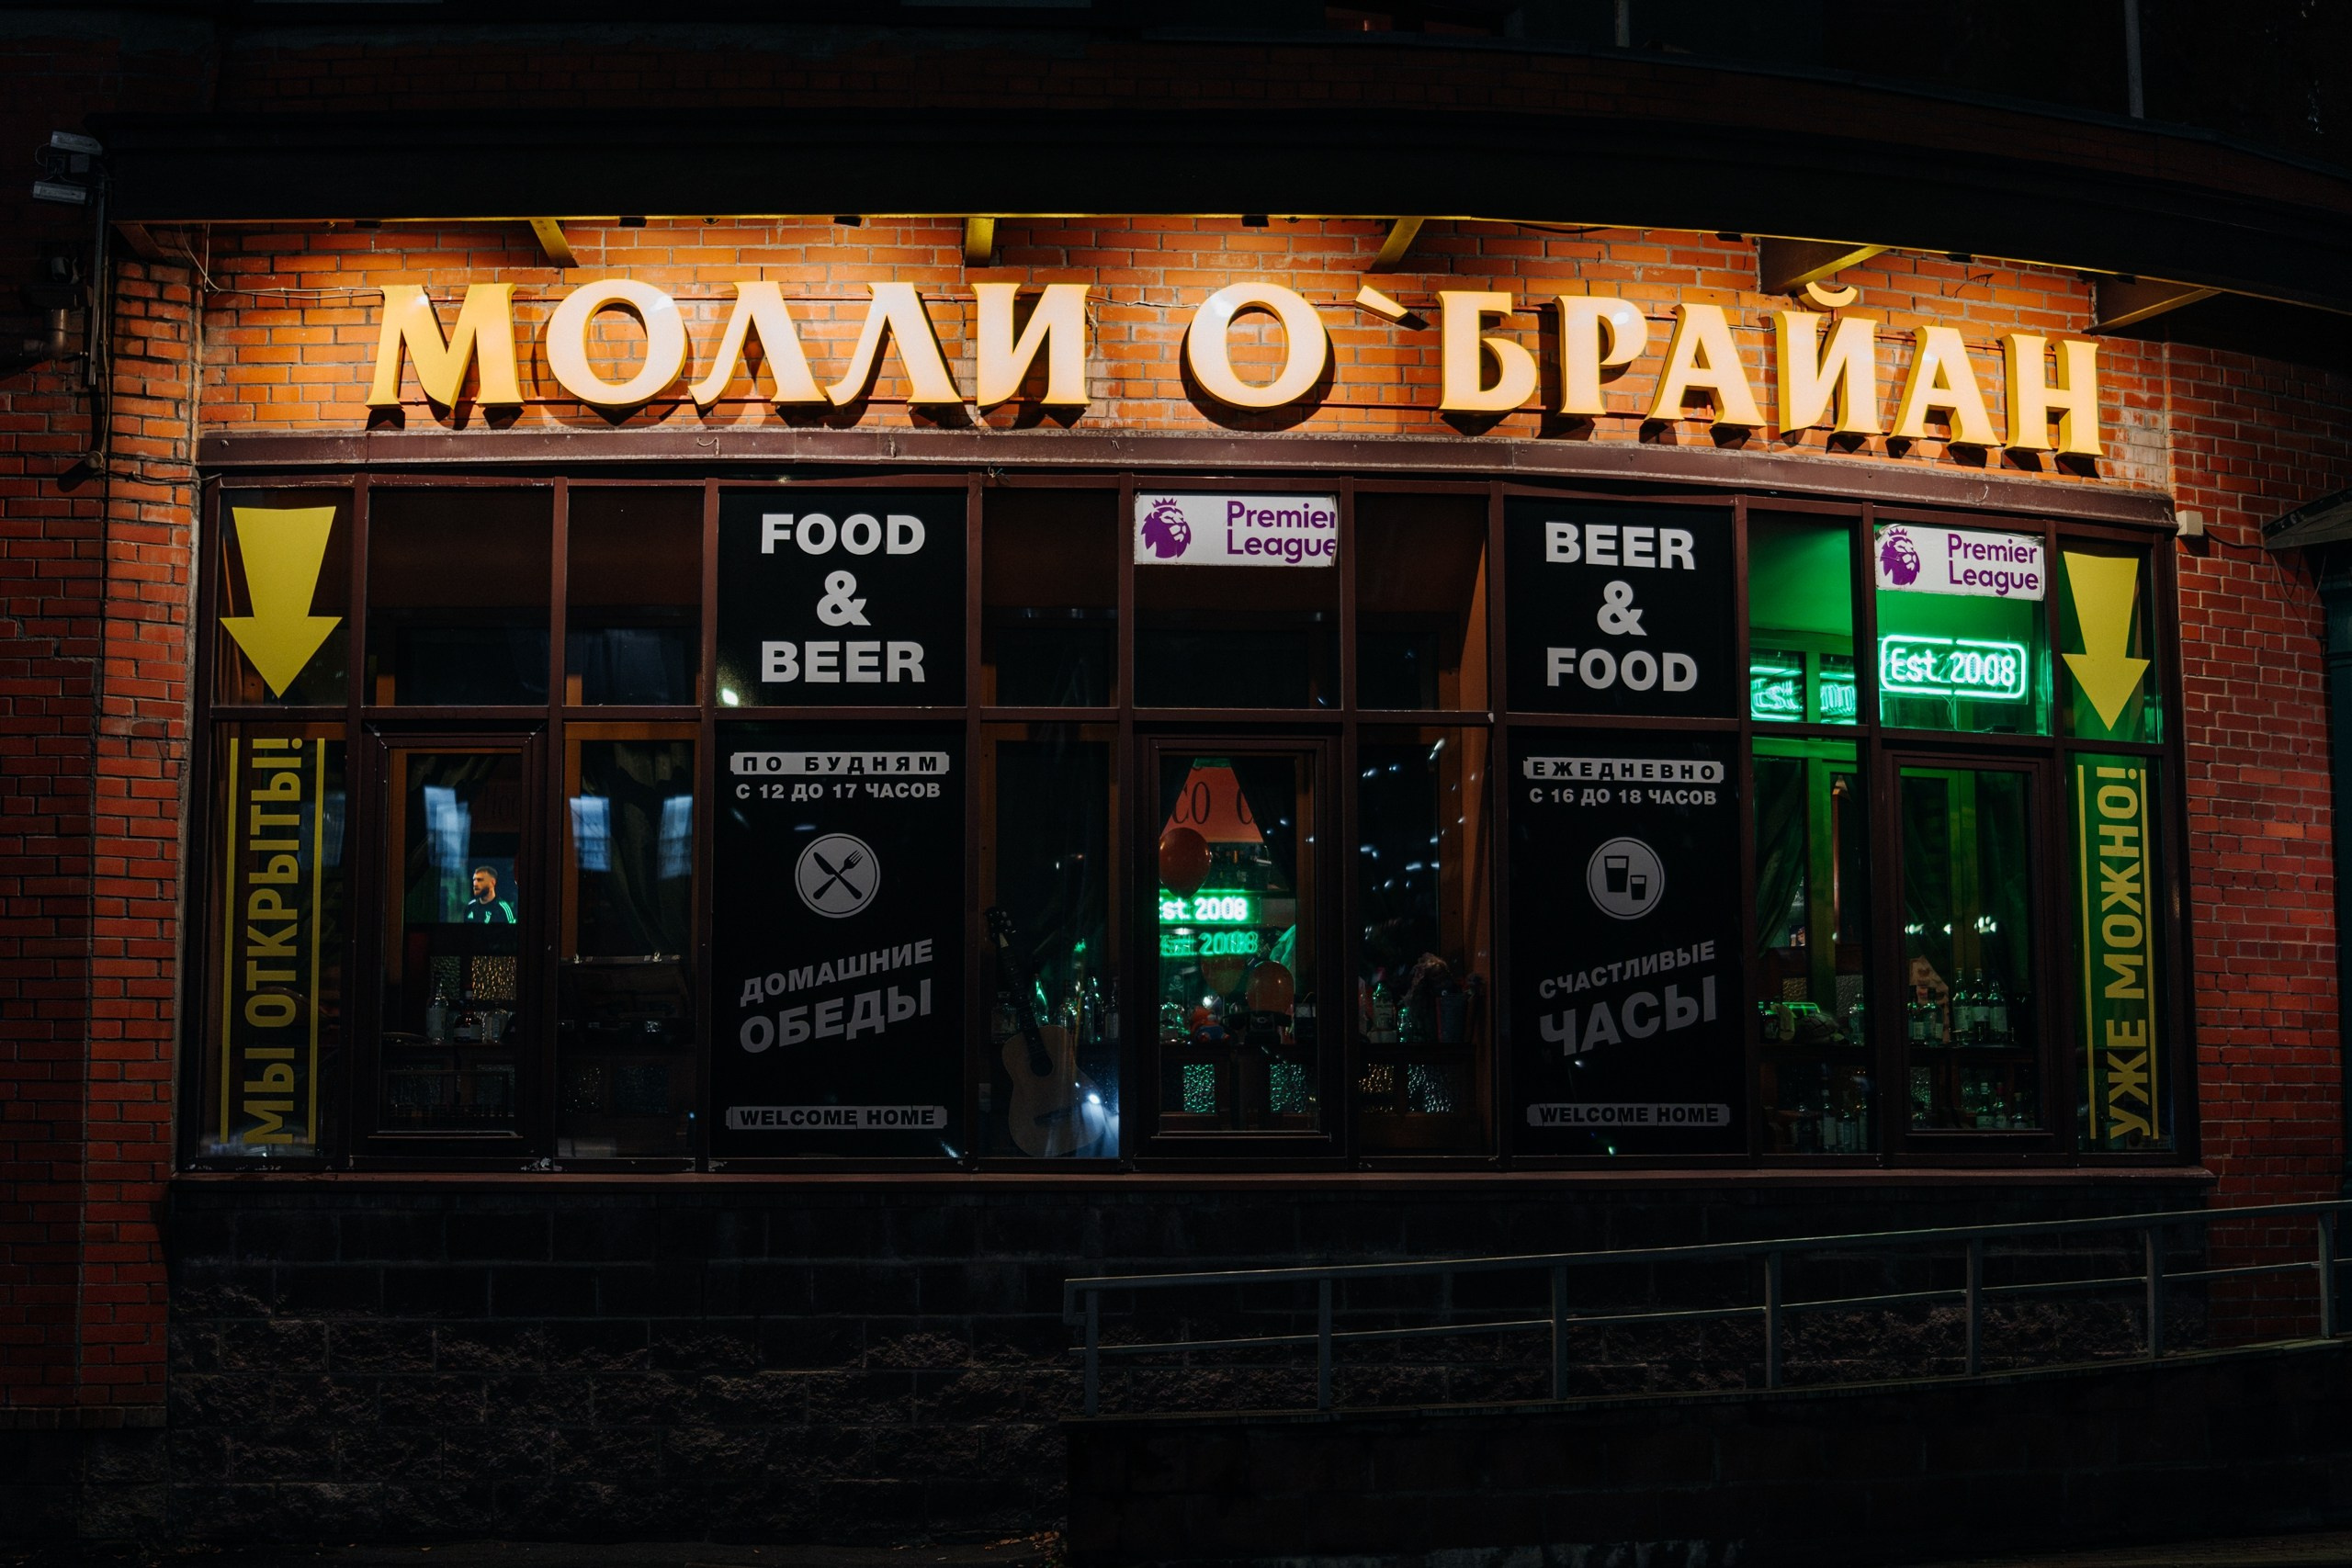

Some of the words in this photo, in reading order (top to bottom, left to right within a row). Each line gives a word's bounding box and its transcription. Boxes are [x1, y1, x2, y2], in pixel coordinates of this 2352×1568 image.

[367, 278, 1091, 410] МОЛЛИ
[761, 513, 926, 556] FOOD
[1227, 529, 1336, 564] League
[1544, 521, 1696, 570] BEER
[1947, 533, 2038, 564] Premier
[816, 570, 872, 627] &
[1949, 560, 2039, 595] League
[1596, 580, 1648, 637] &
[761, 640, 926, 682] BEER
[1546, 647, 1699, 692] FOOD
[1949, 651, 2017, 687] 2008
[742, 756, 782, 773] ПО
[804, 756, 938, 774] БУДНЯМ
[1532, 761, 1715, 781] ЕЖЕДНЕВНО
[735, 783, 751, 800] С
[759, 784, 785, 800] 12
[790, 783, 824, 802] ДО
[831, 784, 857, 799] 17
[865, 783, 941, 799] ЧАСОВ
[1529, 787, 1544, 804] С
[1550, 788, 1575, 804] 16
[1579, 787, 1611, 807] ДО
[1618, 788, 1643, 805] 18
[1648, 789, 1717, 806] ЧАСОВ
[243, 738, 304, 1029] ОТКРЫТЫ!
[2096, 765, 2145, 1000] МОЖНО!
[1193, 896, 1248, 921] 2008
[739, 938, 933, 1008] ДОМАШНИЕ
[1538, 940, 1715, 999] СЧАСТЛИВЫЕ
[739, 977, 933, 1054] ОБЕДЫ
[1539, 975, 1717, 1056] ЧАСЫ
[243, 1047, 296, 1145] МЫ
[2106, 1018, 2151, 1140] УЖЕ
[740, 1109, 858, 1125] WELCOME
[866, 1109, 935, 1125] HOME
[1539, 1107, 1649, 1122] WELCOME
[1657, 1107, 1719, 1122] HOME
